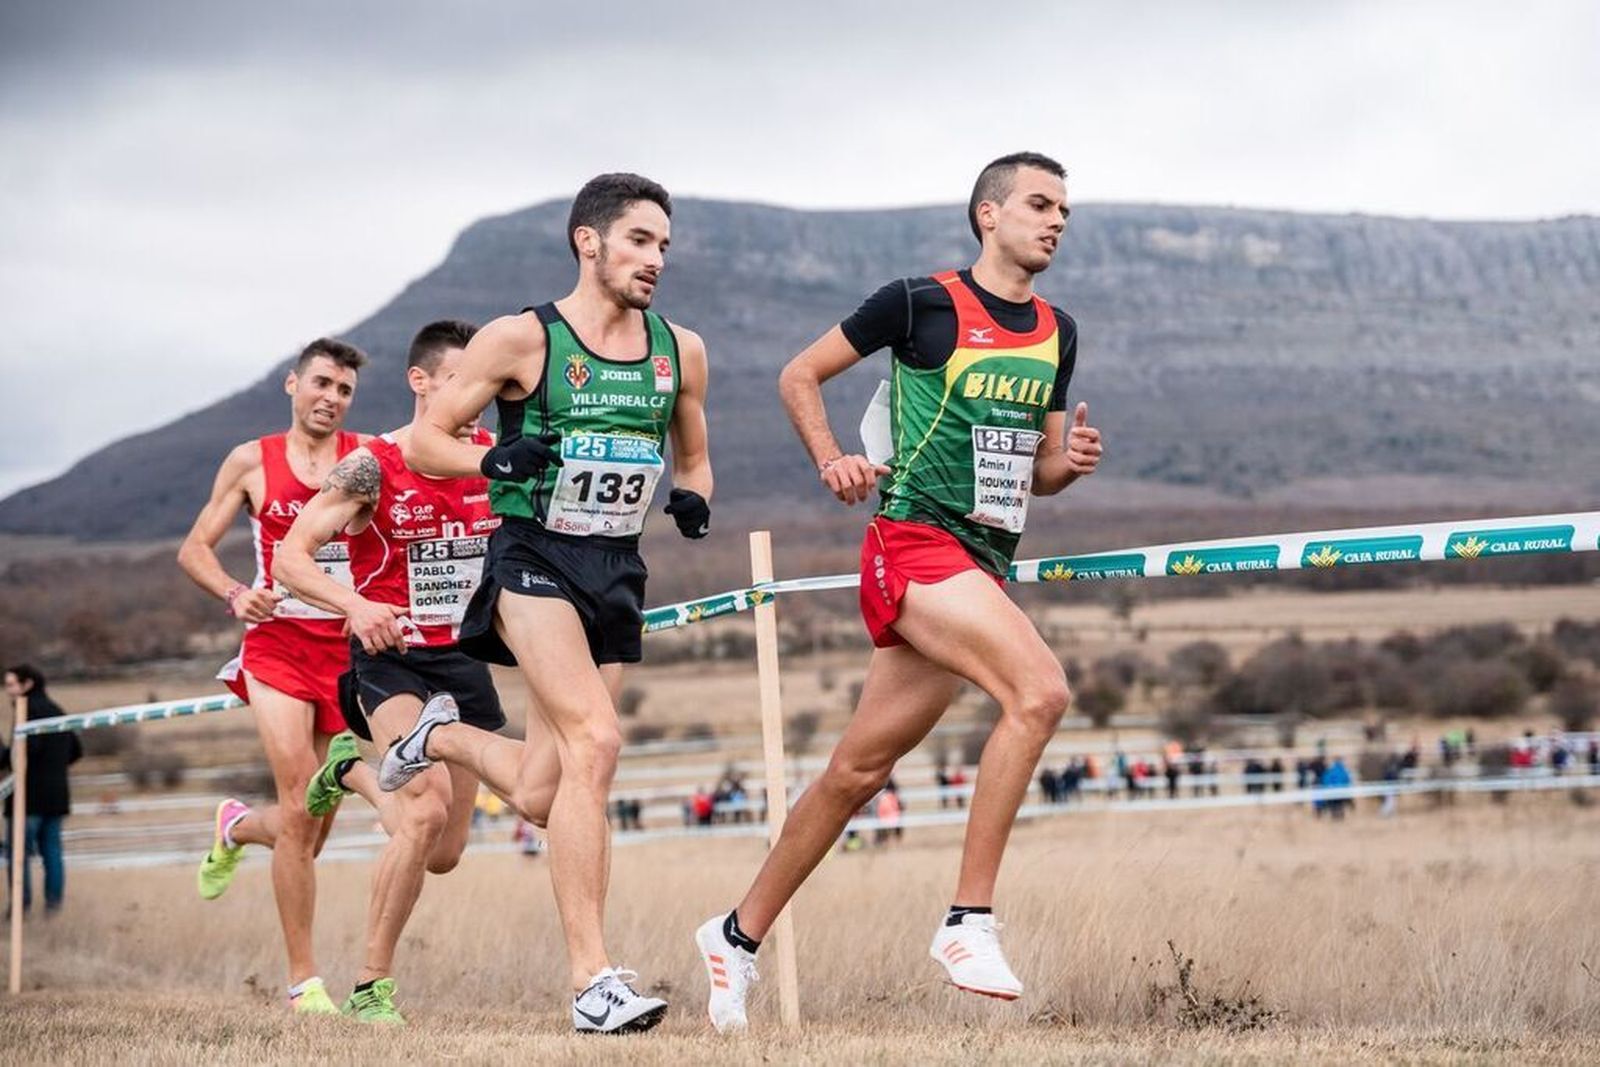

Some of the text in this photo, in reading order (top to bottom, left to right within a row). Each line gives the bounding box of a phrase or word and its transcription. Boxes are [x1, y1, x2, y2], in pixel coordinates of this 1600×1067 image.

[571, 393, 648, 408] VILLARREAL
[576, 436, 607, 458] 25
[985, 430, 1013, 450] 25
[978, 457, 1005, 470] Amin
[571, 471, 646, 505] 133
[420, 542, 450, 559] 25
[1490, 538, 1566, 552] CAJA RURAL
[1343, 549, 1416, 563] CAJA RURAL
[414, 564, 456, 578] PABLO
[1236, 559, 1274, 571] RURAL
[414, 579, 472, 593] SANCHEZ
[415, 594, 459, 607] GOMEZ
